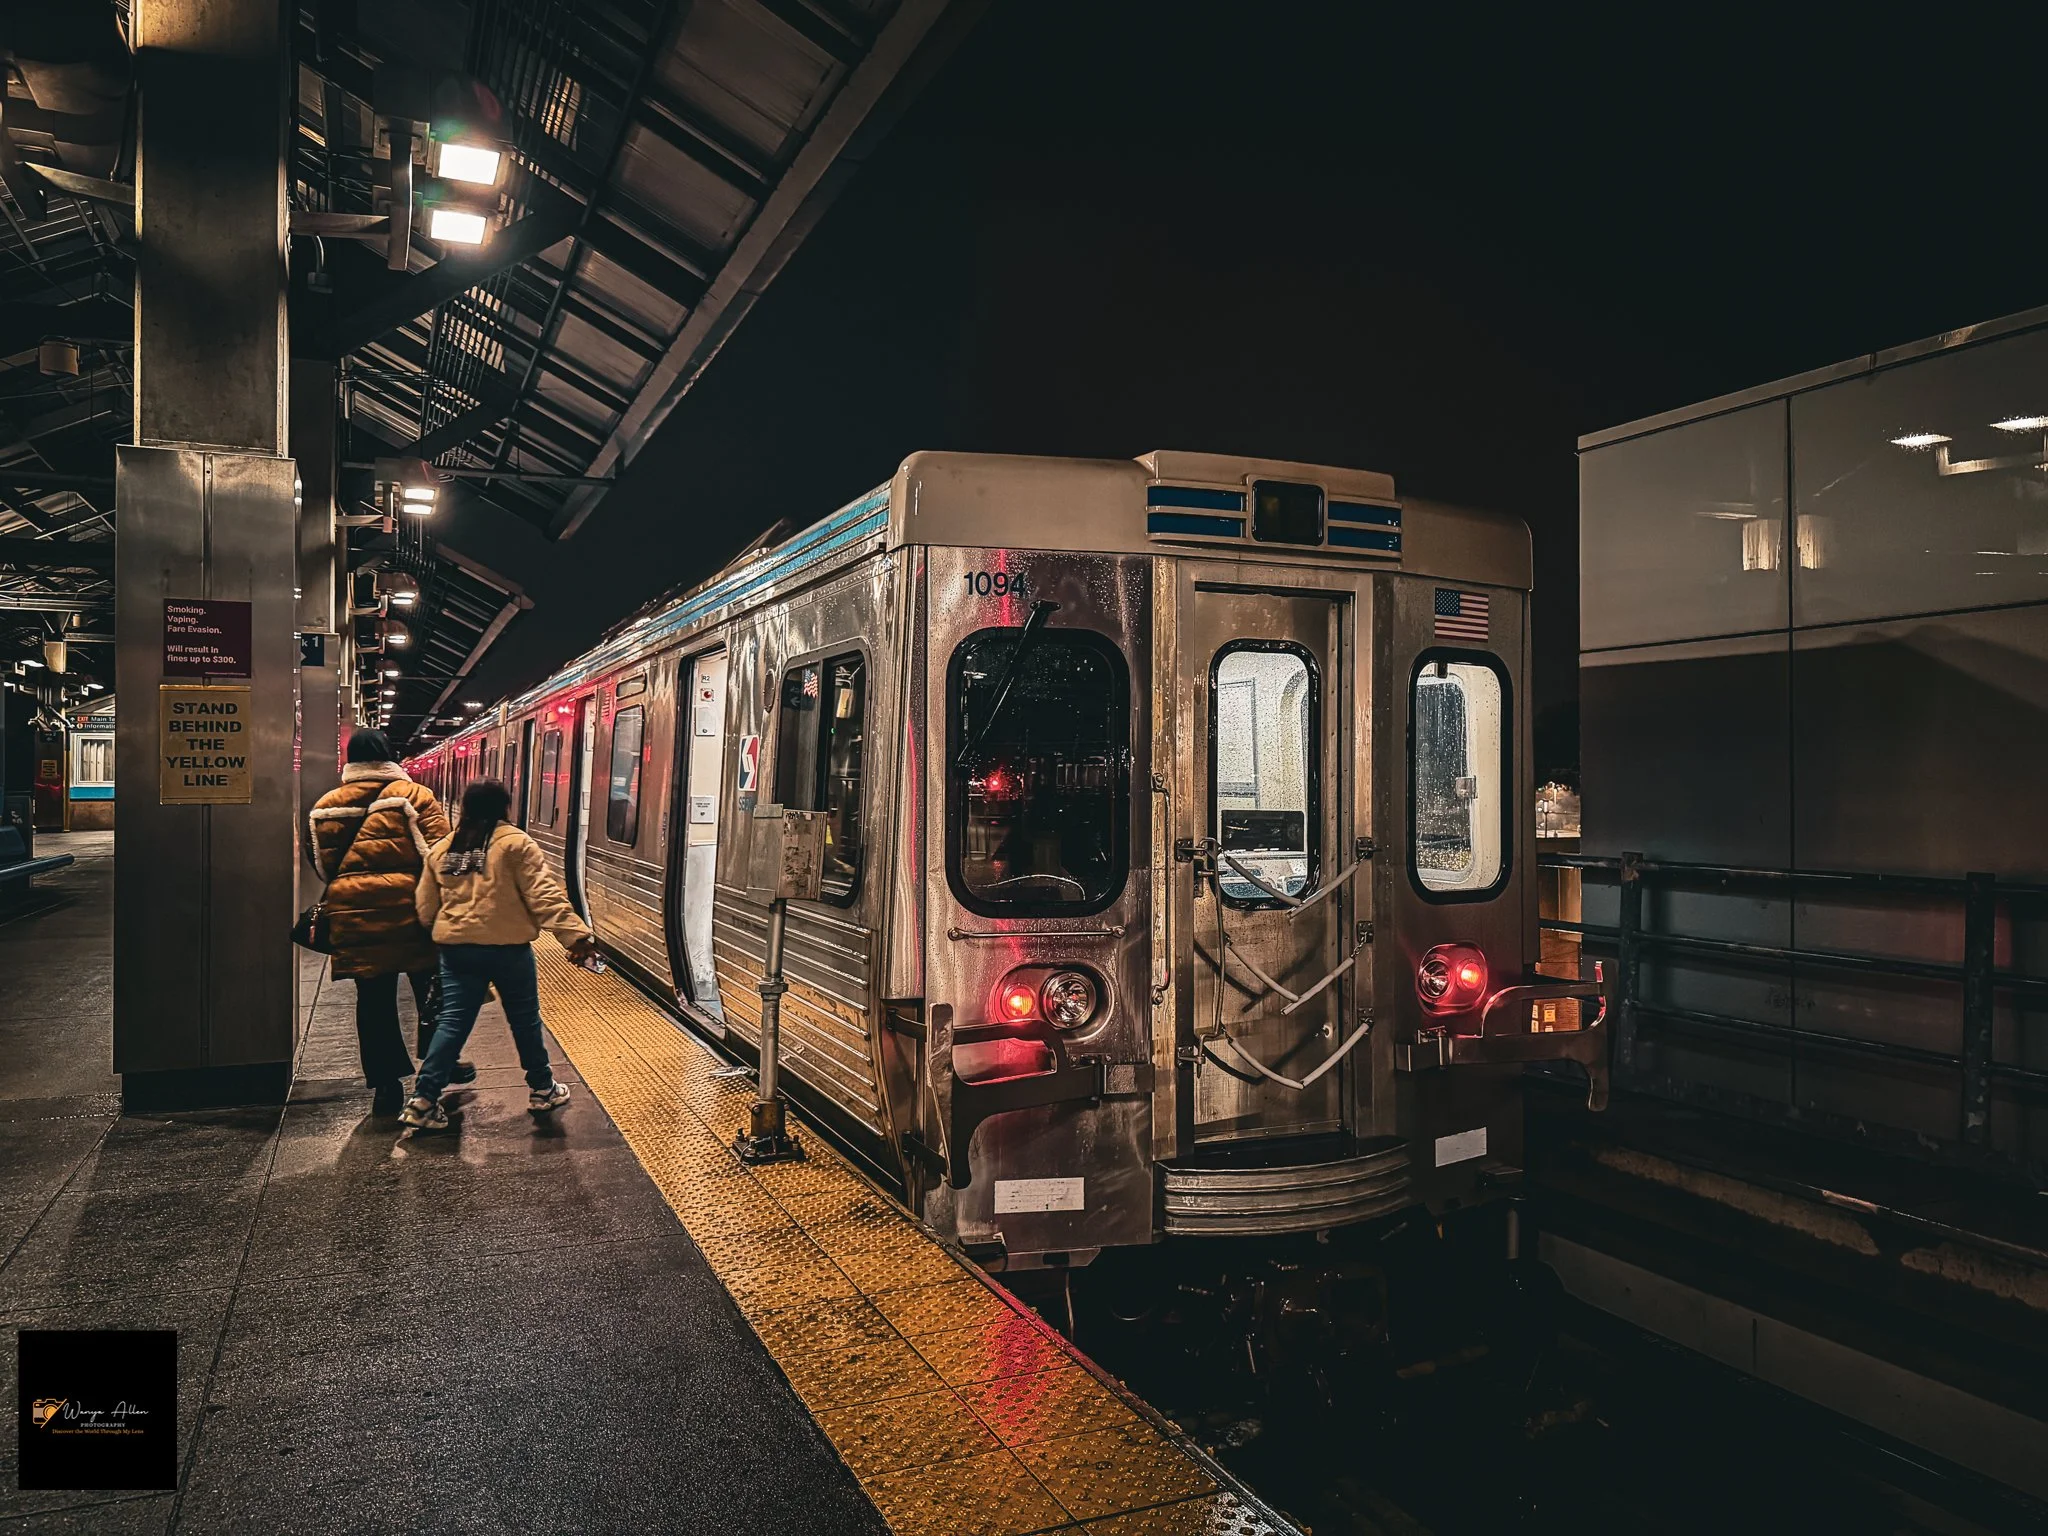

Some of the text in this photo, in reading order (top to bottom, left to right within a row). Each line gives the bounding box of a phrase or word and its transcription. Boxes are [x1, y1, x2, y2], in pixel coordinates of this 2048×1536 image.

[963, 571, 1026, 597] 1094
[167, 605, 207, 615] Smoking.
[167, 615, 199, 625] Vaping.
[167, 625, 222, 634] Fare Evasion.
[312, 635, 319, 648] 1
[167, 645, 219, 654] Will result in
[167, 654, 188, 662] fines
[189, 656, 201, 664] up
[212, 655, 237, 664] $300.
[173, 702, 238, 714] STAND
[168, 720, 242, 733] BEHIND
[185, 738, 225, 751] THE
[165, 756, 246, 769] YELLOW
[183, 774, 229, 787] LINE
